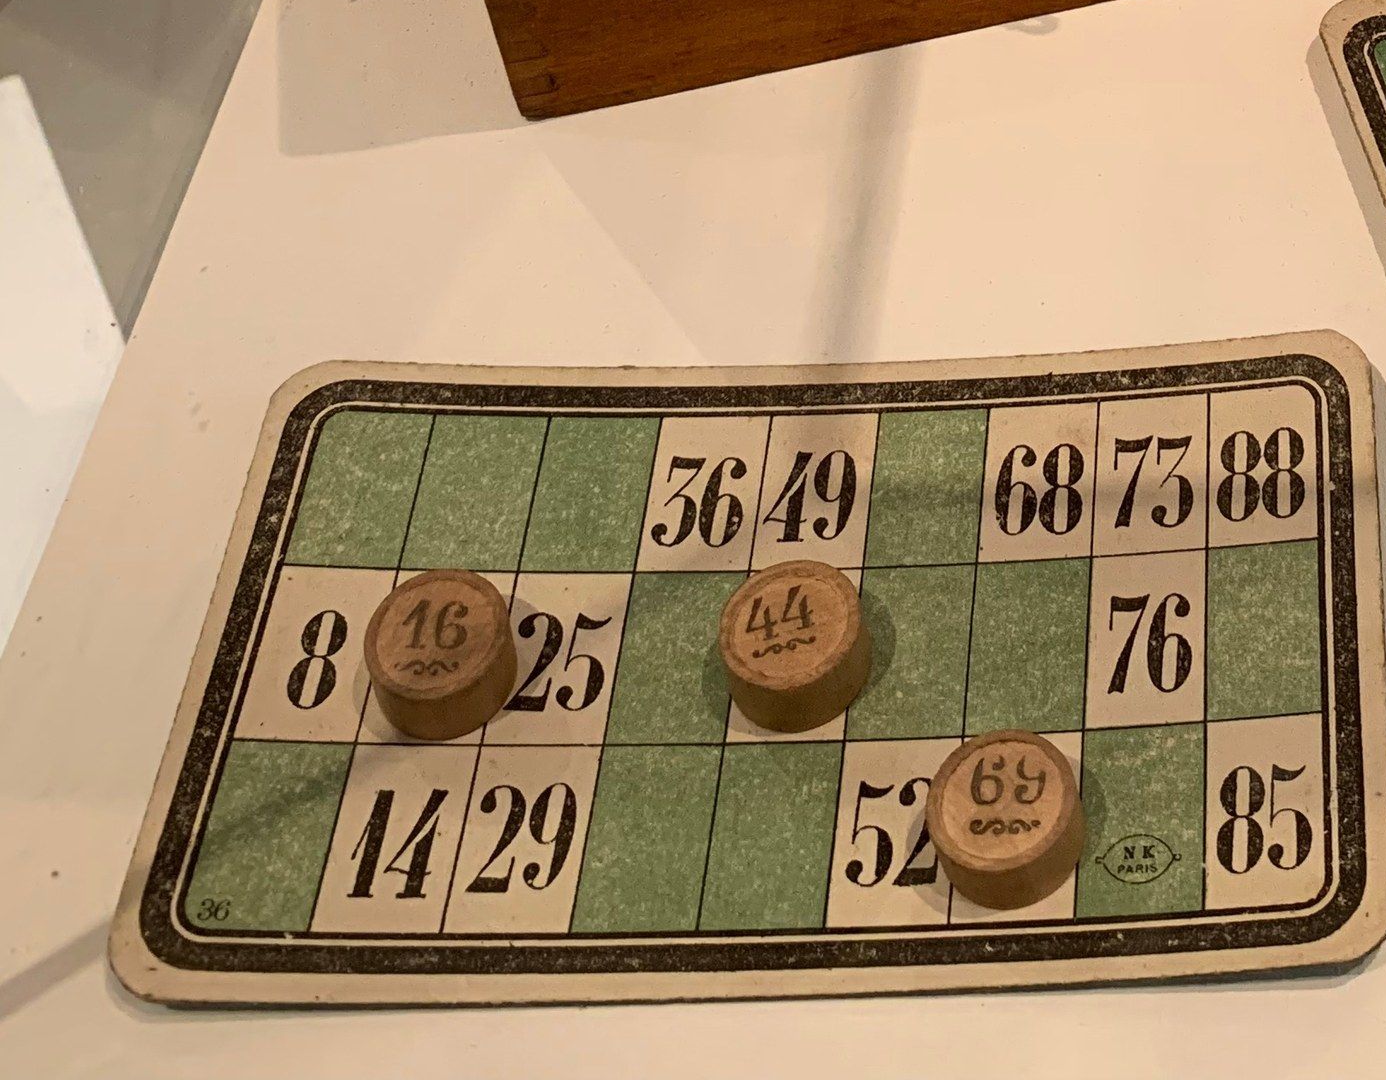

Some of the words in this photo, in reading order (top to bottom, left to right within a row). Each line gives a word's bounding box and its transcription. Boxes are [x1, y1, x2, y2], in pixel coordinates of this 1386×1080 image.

[650, 455, 748, 549] 36
[763, 449, 857, 543] 49
[995, 442, 1085, 536] 68
[1113, 435, 1195, 529] 73
[1215, 426, 1306, 522] 88
[286, 609, 348, 710] 8
[401, 598, 469, 651] 16
[745, 584, 815, 642] 44
[1108, 592, 1192, 695] 76
[503, 611, 613, 712] 25
[968, 754, 1047, 807] 69
[1216, 764, 1313, 874] 85
[347, 788, 449, 899] 14
[465, 782, 577, 894] 29
[845, 777, 939, 888] 52
[1117, 863, 1158, 874] PARIS
[197, 898, 232, 922] 36
